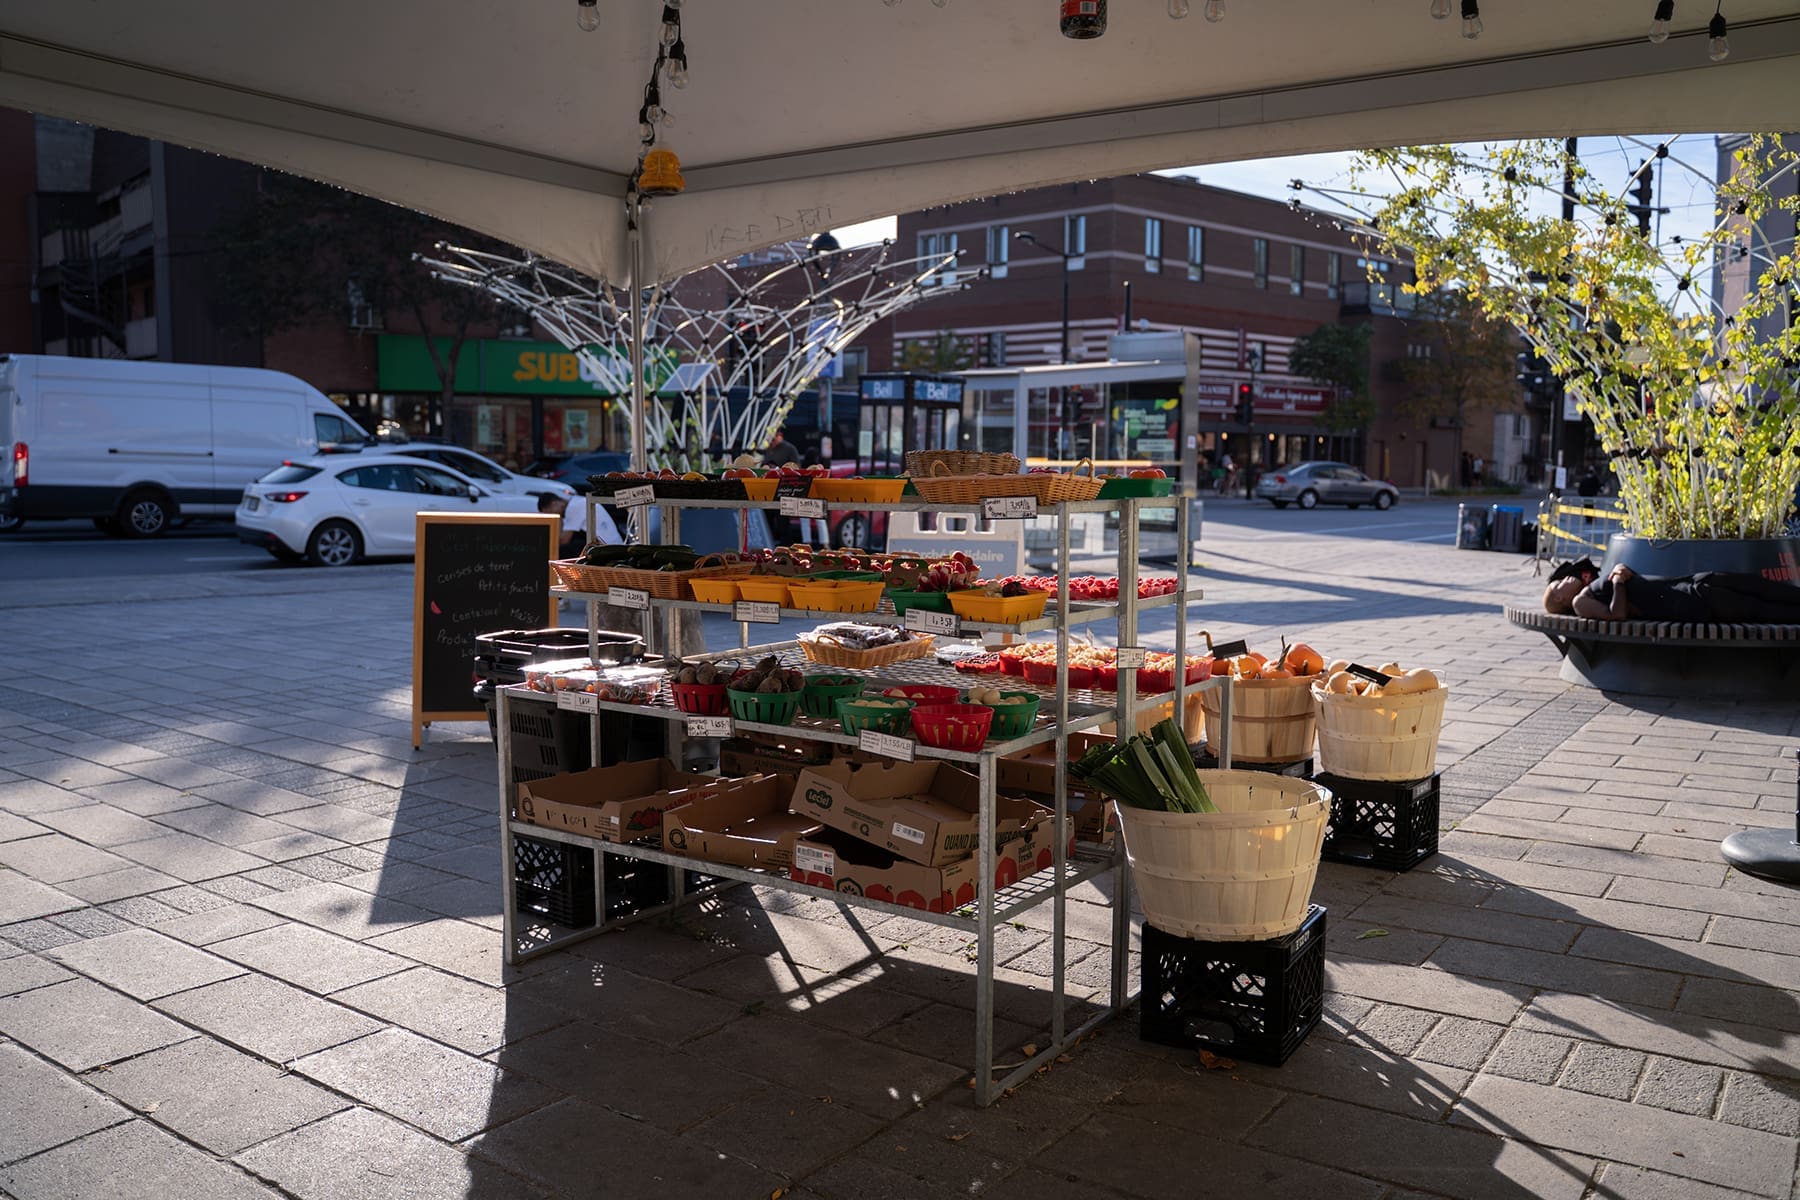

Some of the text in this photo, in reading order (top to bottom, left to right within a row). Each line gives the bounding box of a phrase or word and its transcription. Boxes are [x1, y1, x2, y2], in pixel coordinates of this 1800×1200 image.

[873, 381, 893, 399] Bell
[927, 382, 948, 400] Bell
[474, 563, 485, 572] de
[943, 834, 970, 850] QUAND
